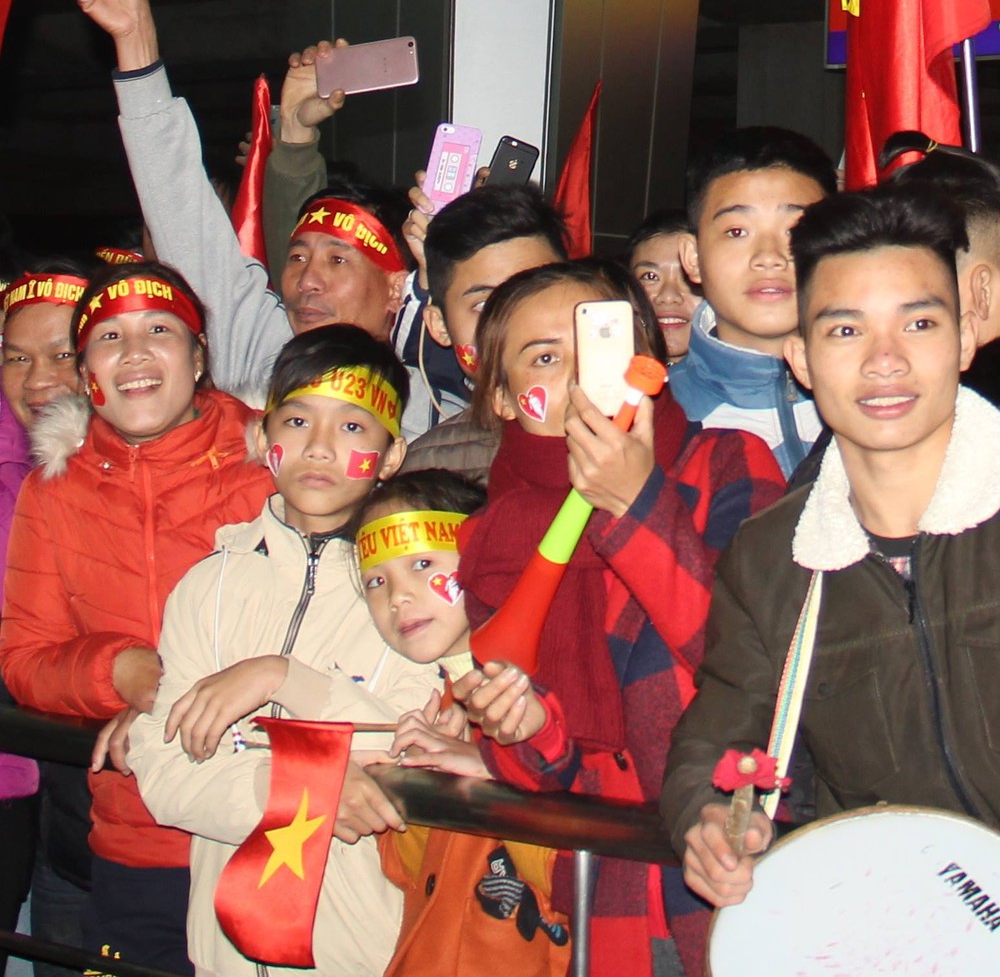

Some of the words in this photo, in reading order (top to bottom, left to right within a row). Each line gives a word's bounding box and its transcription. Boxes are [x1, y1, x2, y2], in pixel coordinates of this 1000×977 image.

[333, 212, 355, 232] VÔ
[37, 278, 53, 298] VÔ
[107, 279, 130, 301] VÔ
[134, 279, 174, 302] ĐỊCH
[380, 517, 420, 551] VIỆT
